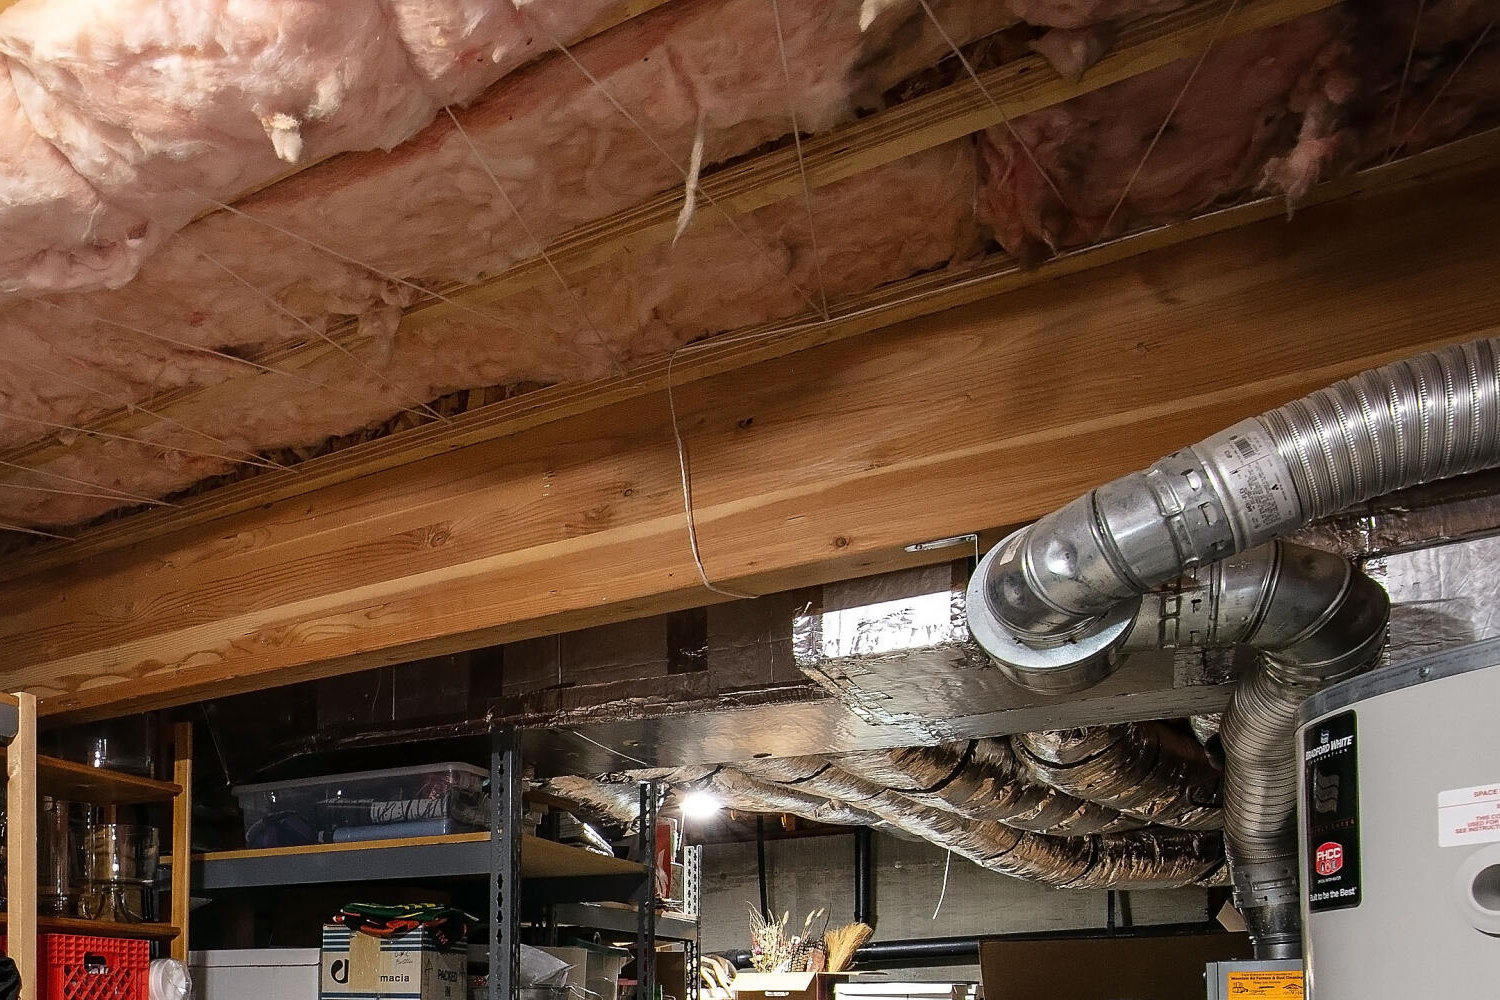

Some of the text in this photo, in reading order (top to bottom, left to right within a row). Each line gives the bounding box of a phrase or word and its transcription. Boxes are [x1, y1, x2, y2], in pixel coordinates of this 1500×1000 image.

[1331, 735, 1354, 751] WHITE
[1474, 789, 1498, 797] SPACE
[1317, 847, 1341, 862] PHCC
[1340, 887, 1356, 897] Best
[380, 972, 410, 983] macia
